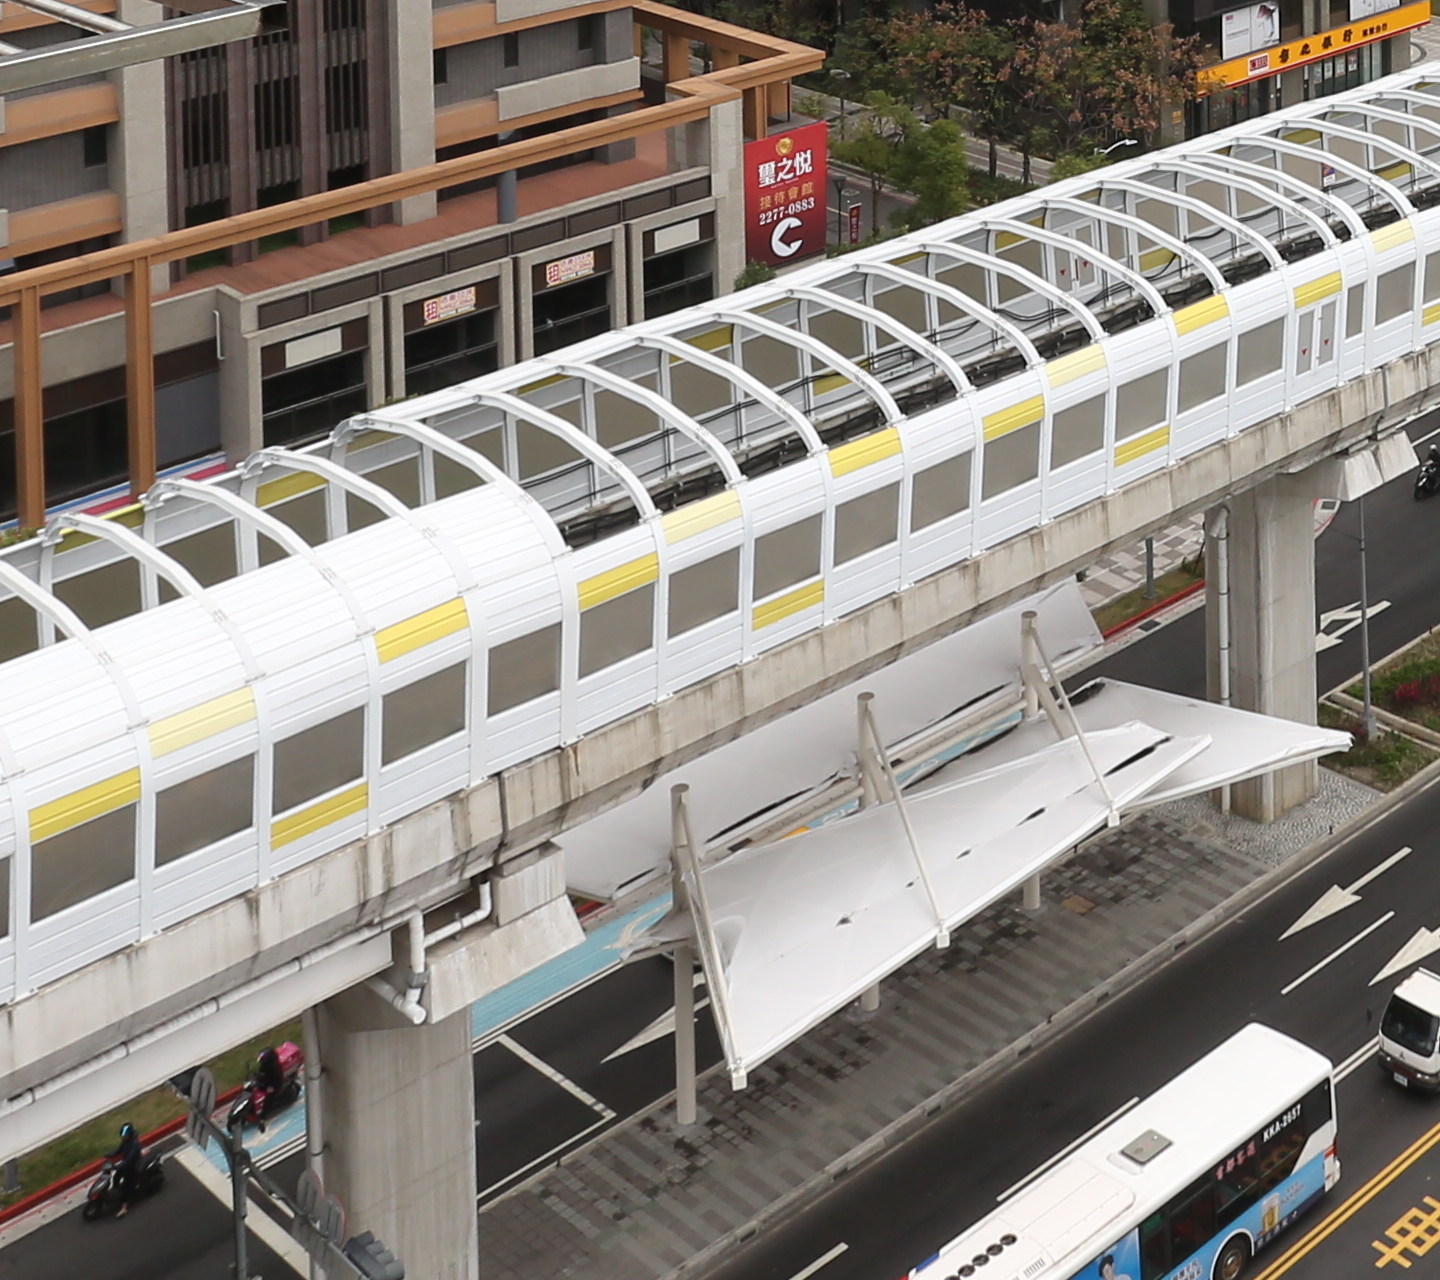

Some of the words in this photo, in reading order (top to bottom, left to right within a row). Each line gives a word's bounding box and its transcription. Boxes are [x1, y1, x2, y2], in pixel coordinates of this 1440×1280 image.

[759, 181, 814, 210] 接待會館
[759, 197, 815, 226] 2277-0883
[1262, 1103, 1302, 1143] KKA-2657
